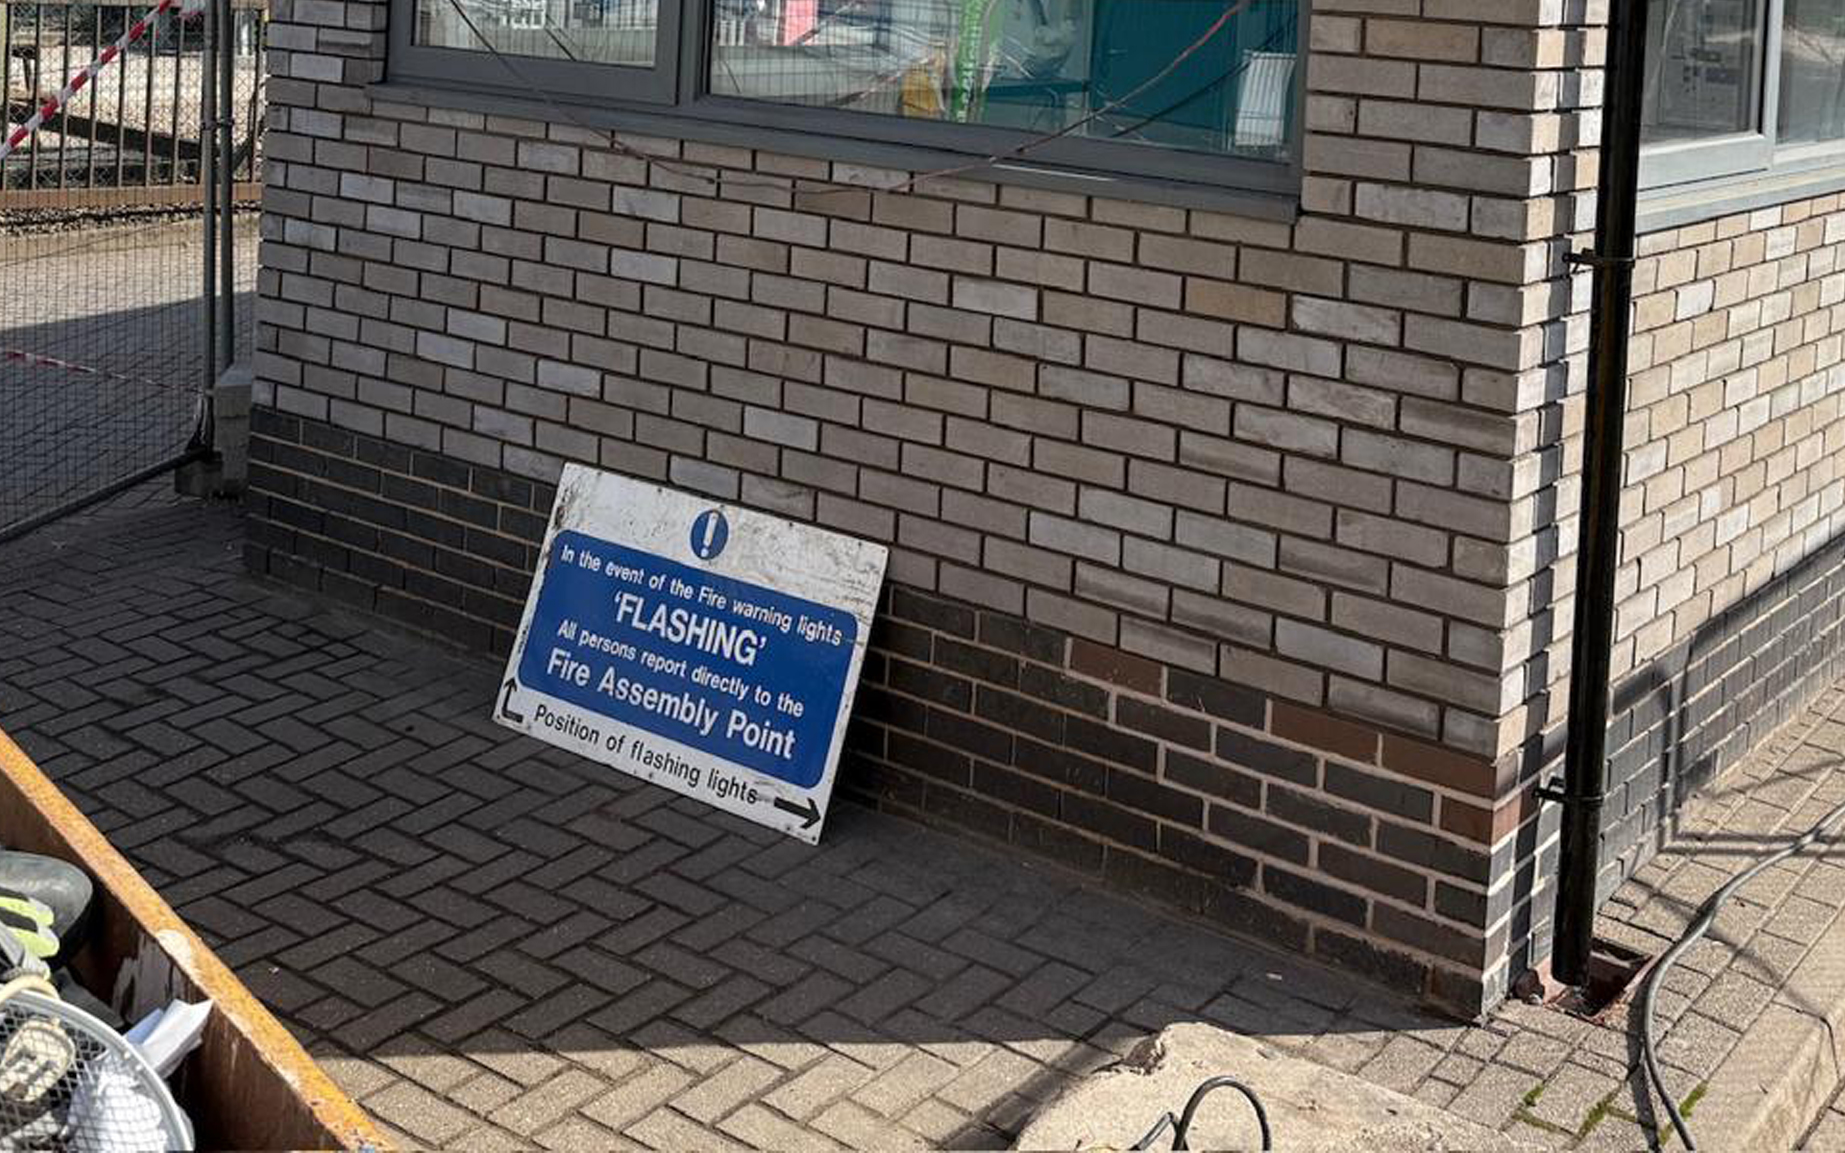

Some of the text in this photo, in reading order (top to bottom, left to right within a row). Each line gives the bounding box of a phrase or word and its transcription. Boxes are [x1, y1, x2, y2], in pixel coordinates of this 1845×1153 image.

[561, 545, 842, 645] In the event of the Fire warning lights
[547, 648, 797, 759] Fire Assembly Point
[558, 620, 804, 717] All persons report directly to the
[533, 704, 758, 804] Position of flashing lights
